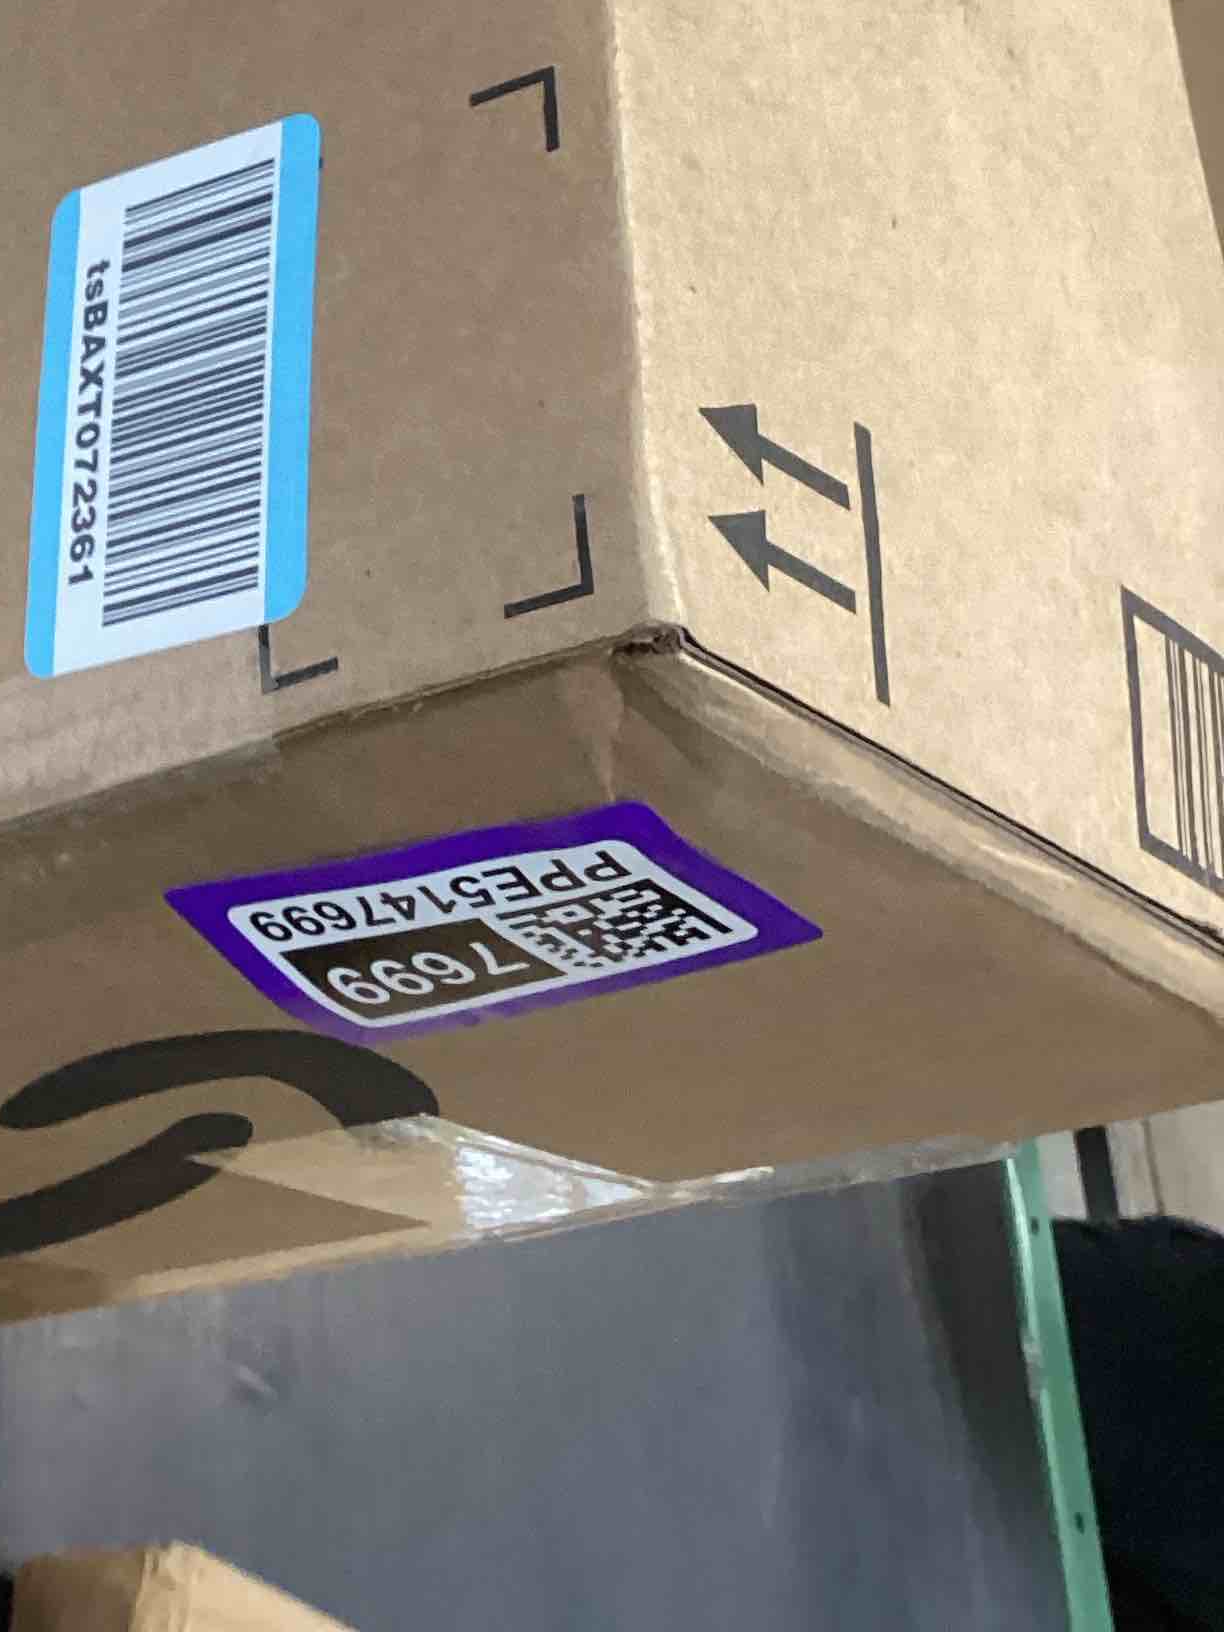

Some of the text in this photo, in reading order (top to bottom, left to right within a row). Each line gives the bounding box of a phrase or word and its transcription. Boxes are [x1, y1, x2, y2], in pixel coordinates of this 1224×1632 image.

[68, 257, 112, 587] tsBAXT072361
[248, 849, 633, 945] PPE5147699
[327, 941, 533, 1008] 7699
